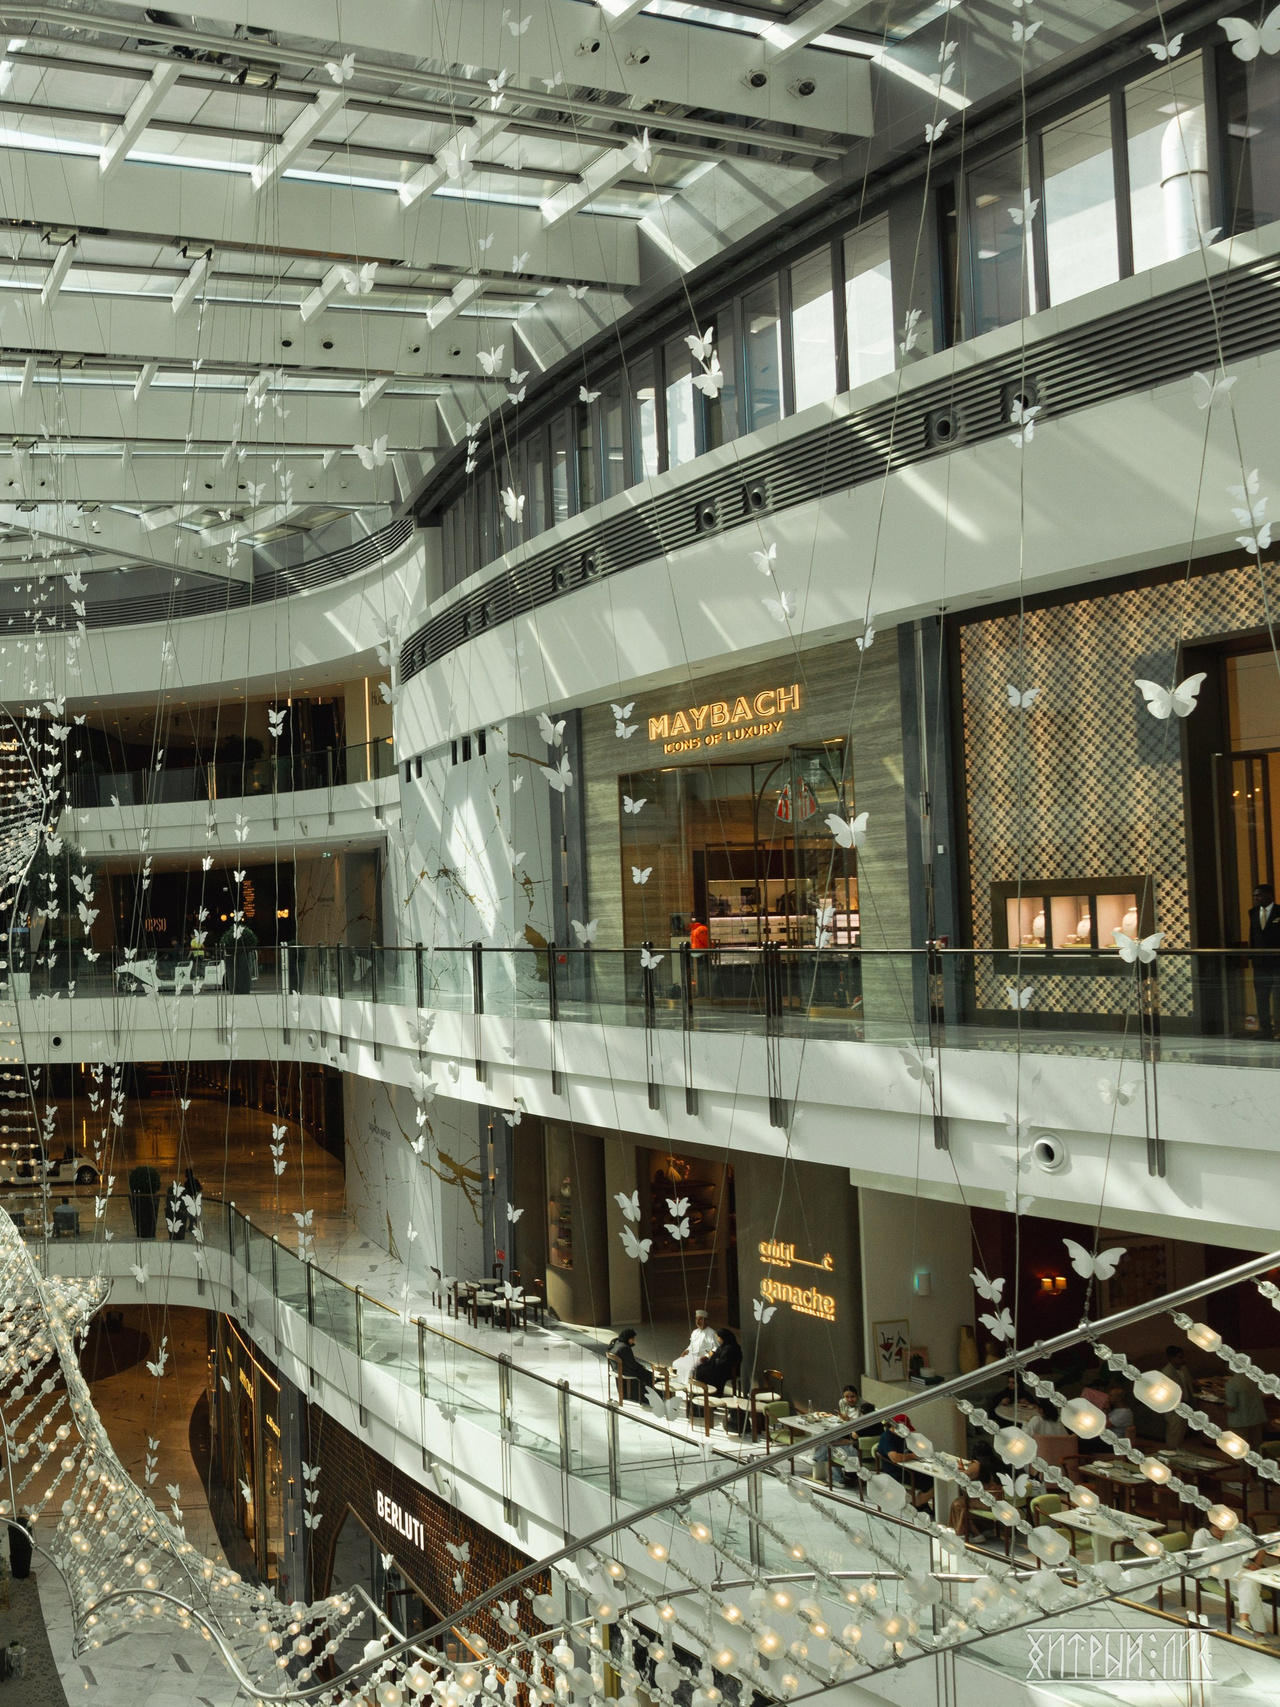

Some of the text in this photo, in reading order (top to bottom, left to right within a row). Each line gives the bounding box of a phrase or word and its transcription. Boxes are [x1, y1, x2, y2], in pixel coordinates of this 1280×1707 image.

[648, 684, 800, 740] MAYBACH
[663, 720, 783, 755] ICONS OF LUXURY
[145, 918, 167, 932] OPSO
[760, 1279, 835, 1315] ganache
[377, 1490, 425, 1551] BERLUTI
